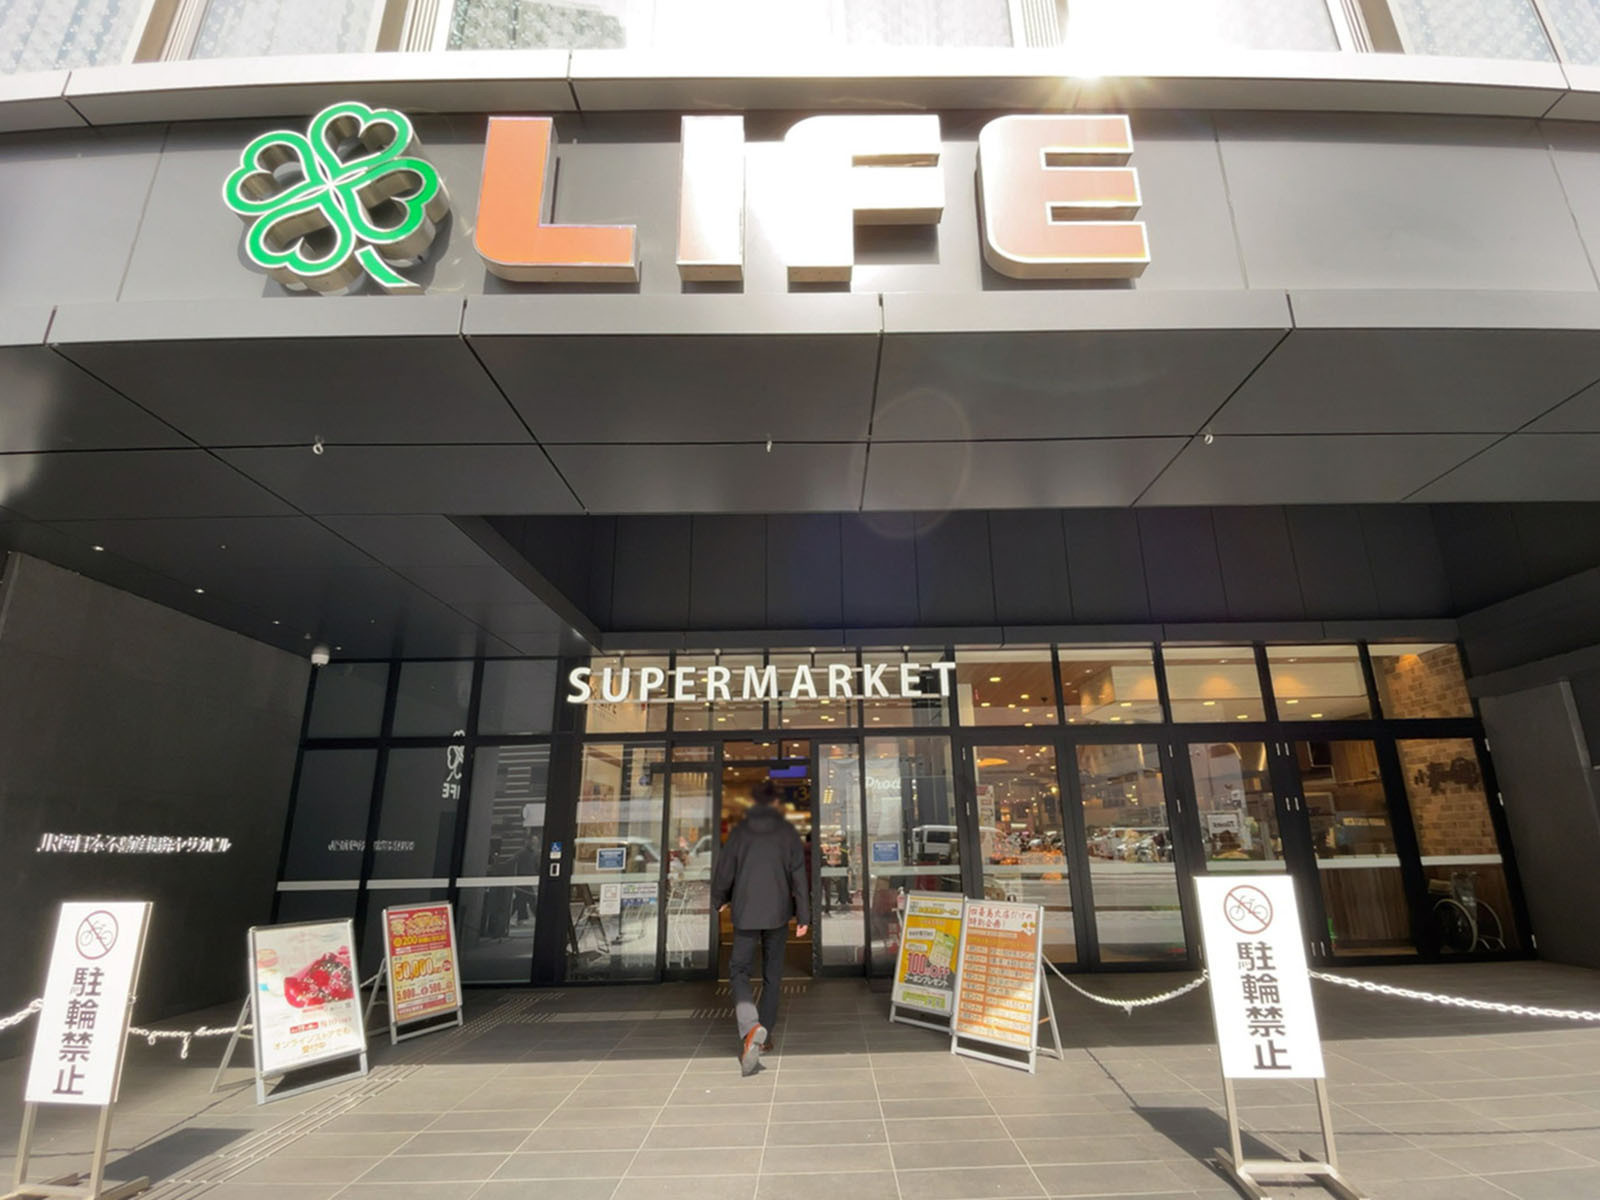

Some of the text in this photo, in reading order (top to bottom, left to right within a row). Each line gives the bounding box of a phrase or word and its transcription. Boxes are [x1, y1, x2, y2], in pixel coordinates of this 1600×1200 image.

[473, 113, 1151, 285] LIFE
[567, 660, 957, 704] SUPERMARKET
[52, 967, 105, 1096] 駐輪禁止
[1236, 940, 1292, 1071] 駐輪禁止
